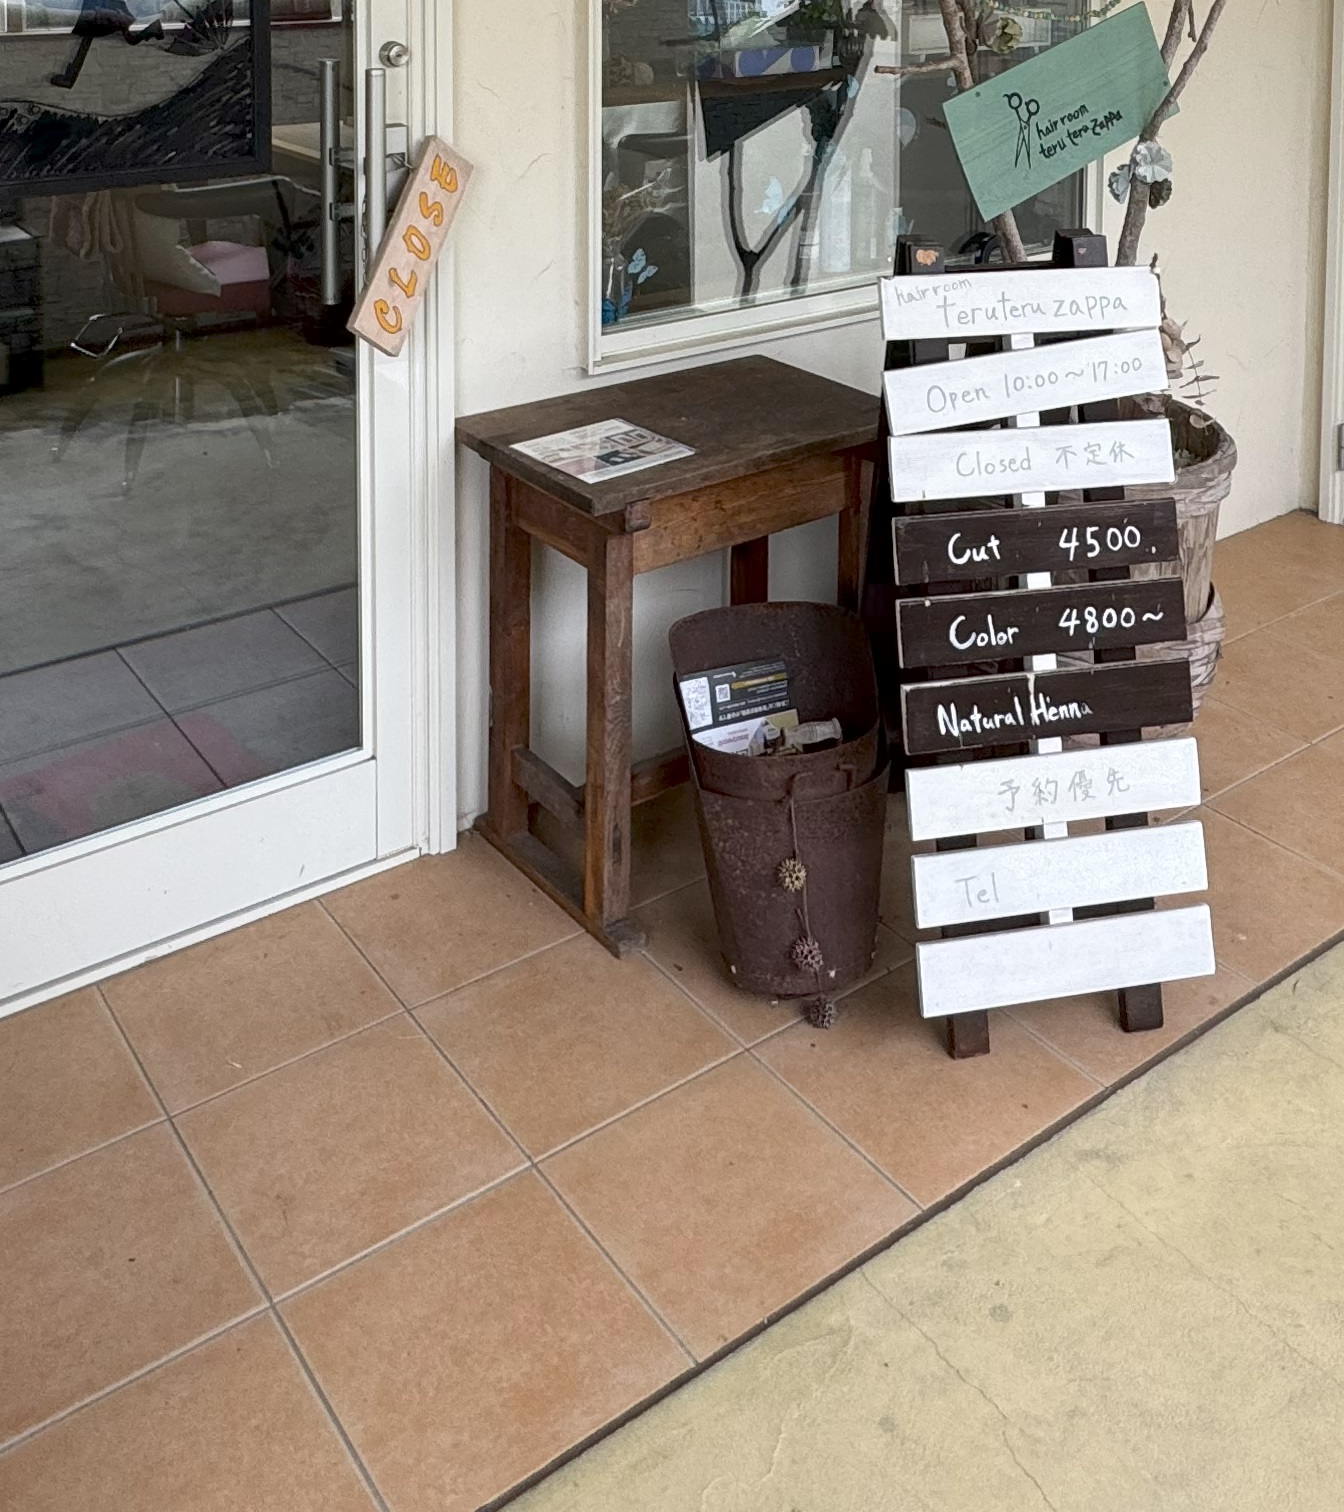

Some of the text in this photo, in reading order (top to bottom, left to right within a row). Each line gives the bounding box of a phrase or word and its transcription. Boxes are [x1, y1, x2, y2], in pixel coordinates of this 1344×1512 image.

[1035, 104, 1089, 140] hair room
[1039, 137, 1066, 159] teru
[374, 154, 458, 334] CLOSE
[1053, 295, 1127, 319] zappa
[927, 385, 989, 413] Open
[956, 440, 1135, 476] Closed 不定休
[948, 533, 1001, 564] Cut
[949, 614, 1020, 650] Color
[936, 692, 1094, 737] Natural Henna
[997, 767, 1130, 812] 予約優先
[955, 872, 999, 908] Tel
